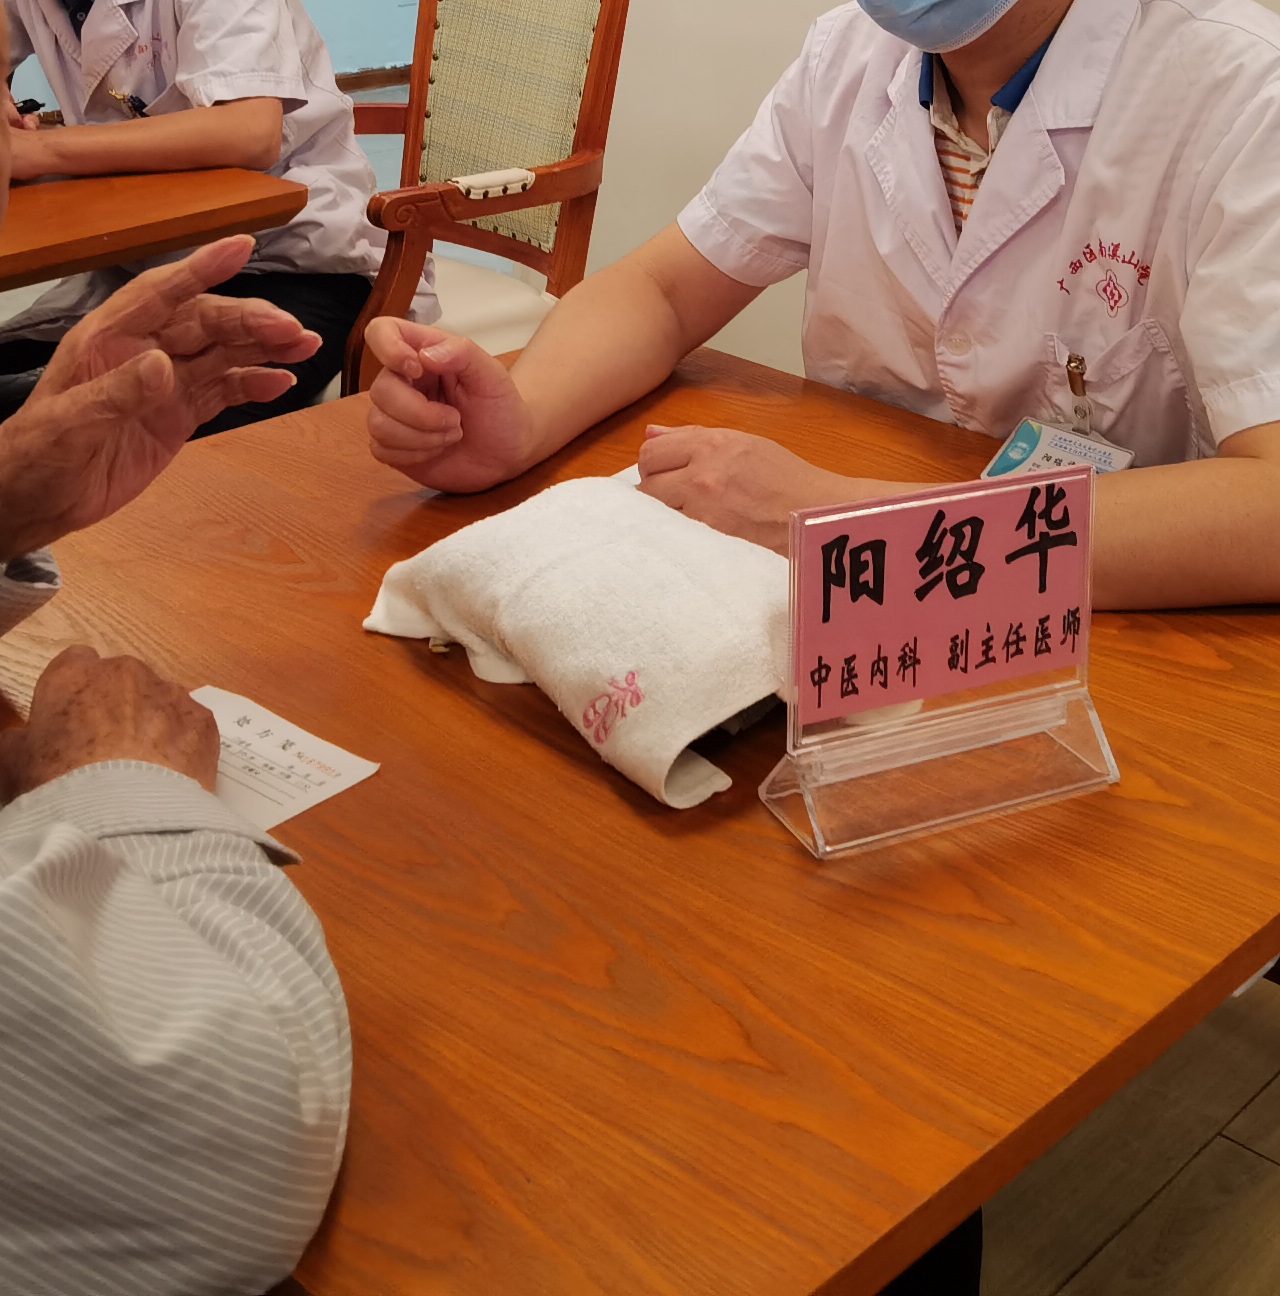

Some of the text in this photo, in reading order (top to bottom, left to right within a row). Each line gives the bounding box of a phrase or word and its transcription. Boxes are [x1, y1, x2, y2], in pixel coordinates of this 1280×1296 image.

[820, 483, 1078, 623] 阳绍华
[809, 606, 1081, 709] 中医内科 副主任医师
